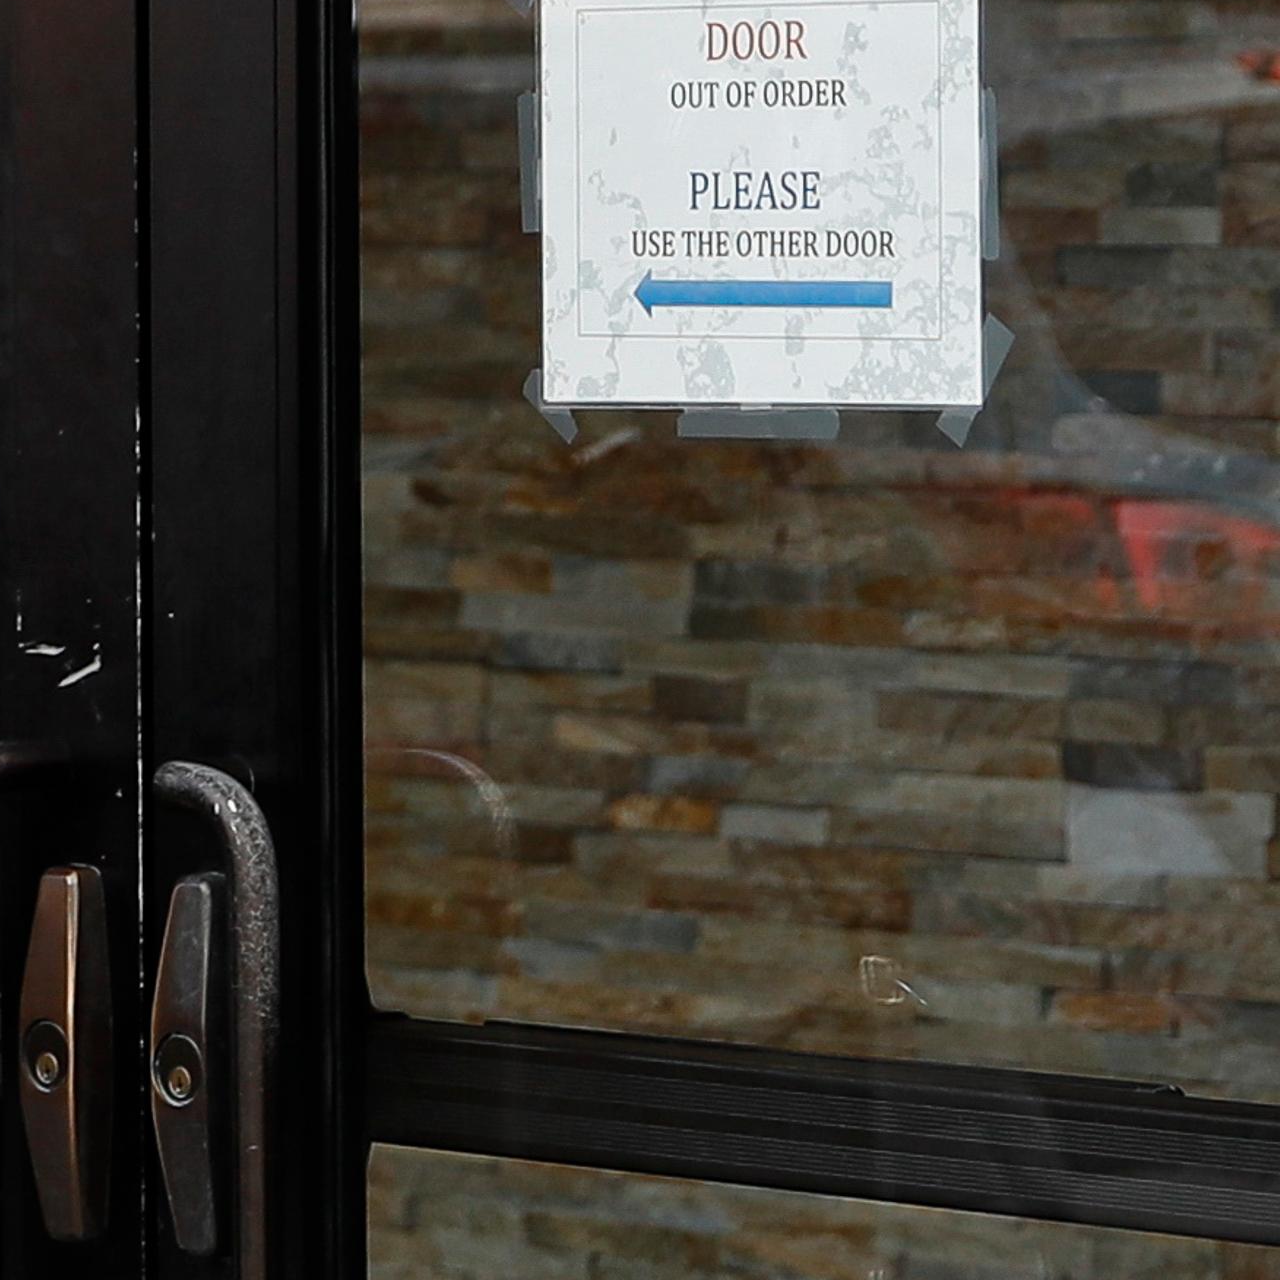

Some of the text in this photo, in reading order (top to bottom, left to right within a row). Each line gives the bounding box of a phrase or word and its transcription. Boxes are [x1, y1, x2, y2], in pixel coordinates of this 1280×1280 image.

[706, 20, 808, 61] DOOR
[670, 80, 847, 109] OUT OF ORDER
[689, 171, 821, 211] PLEASE
[632, 230, 895, 258] USE THE OTHER DOOR
